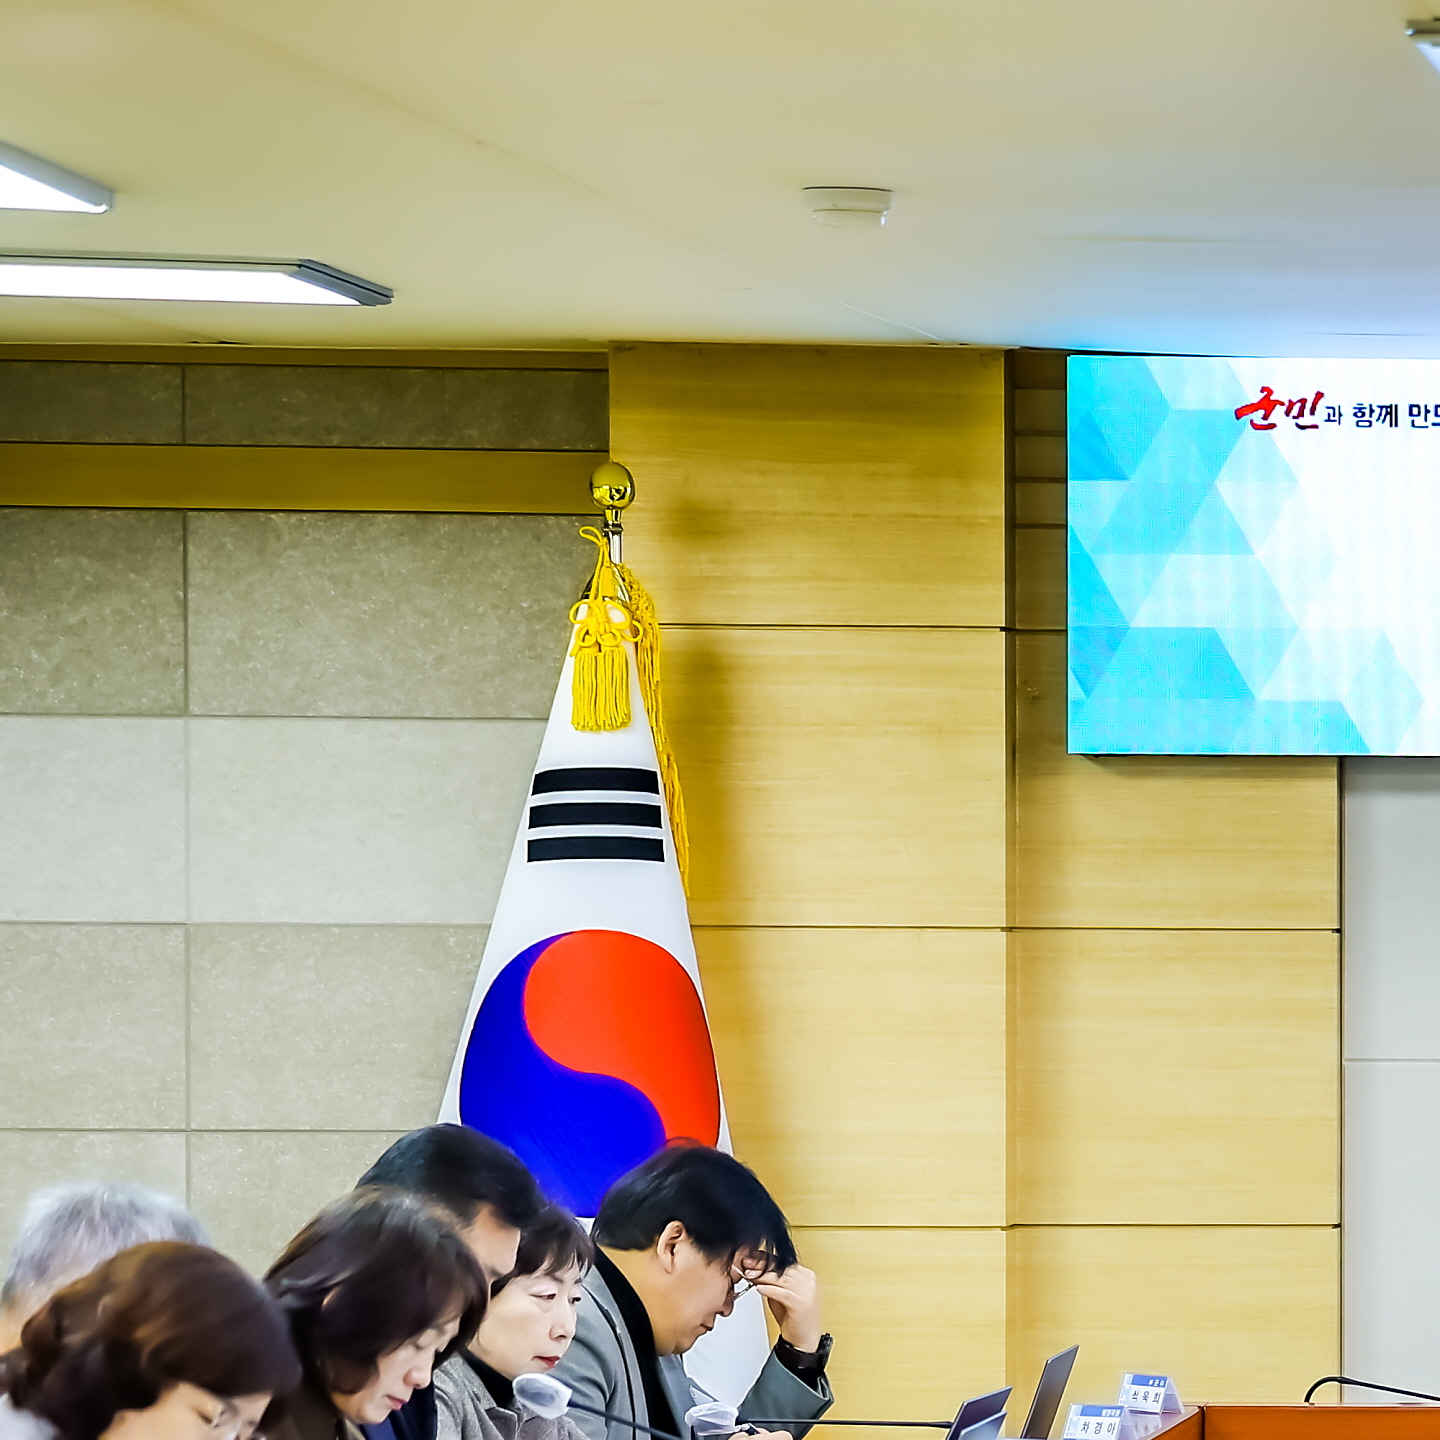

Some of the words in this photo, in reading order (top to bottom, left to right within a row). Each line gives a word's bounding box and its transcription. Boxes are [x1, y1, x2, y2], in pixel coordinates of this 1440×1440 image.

[1235, 386, 1343, 430] 군민과
[1352, 403, 1399, 429] 함께
[1080, 1421, 1117, 1436] 차경아
